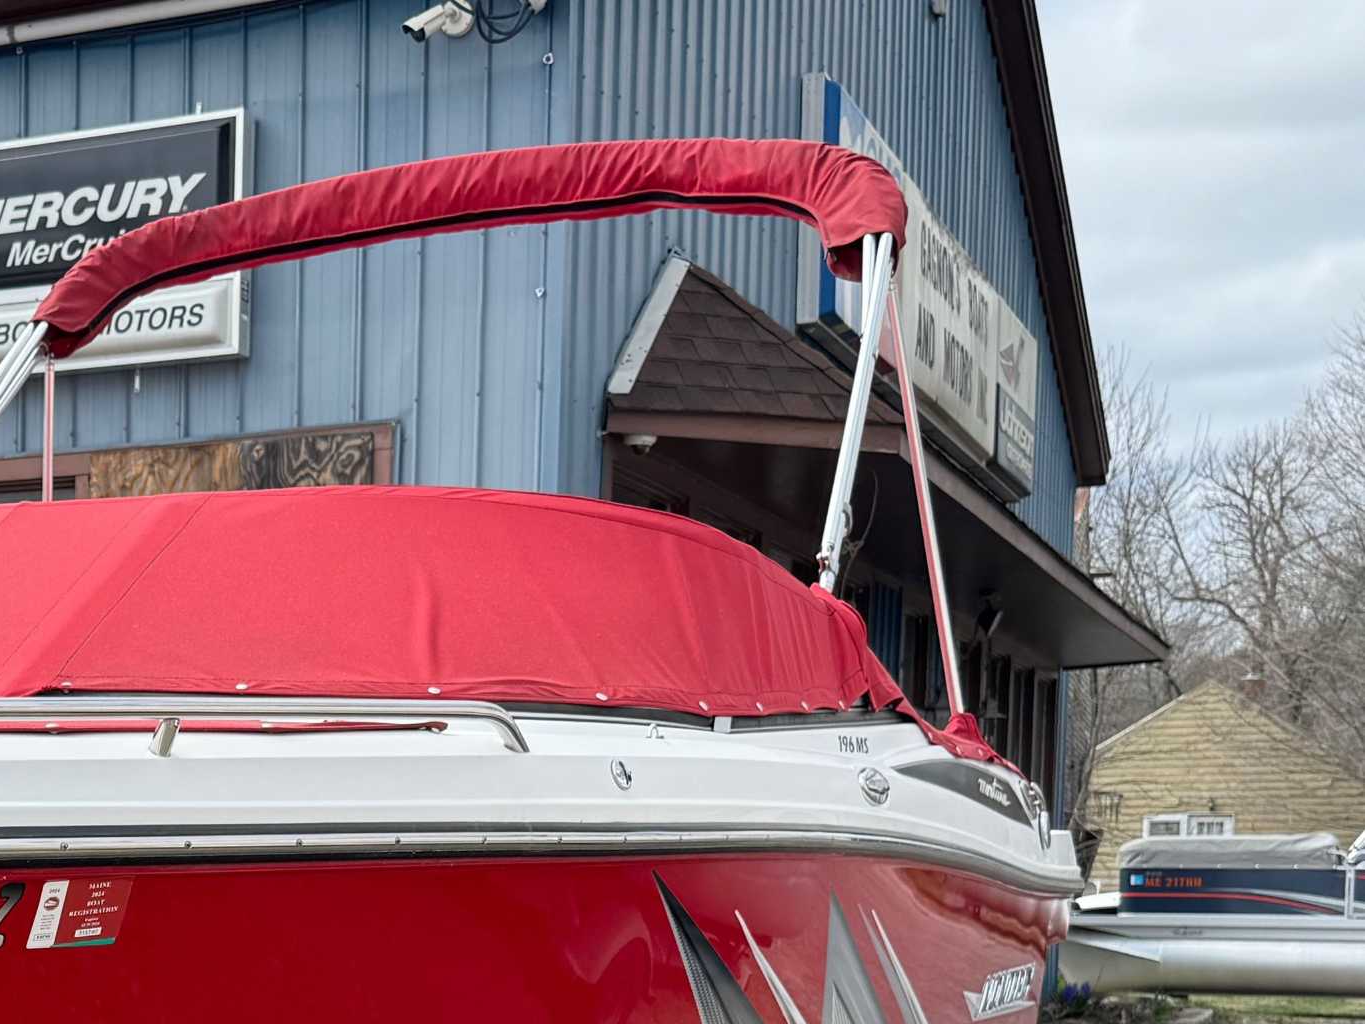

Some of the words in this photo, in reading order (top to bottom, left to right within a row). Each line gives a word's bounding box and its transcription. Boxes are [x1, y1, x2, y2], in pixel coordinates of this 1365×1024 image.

[100, 303, 205, 336] OTORS
[915, 302, 936, 371] AND
[837, 735, 855, 753] 196
[855, 736, 869, 754] MS
[88, 881, 112, 889] MAINE
[68, 906, 119, 917] REGISTRATION
